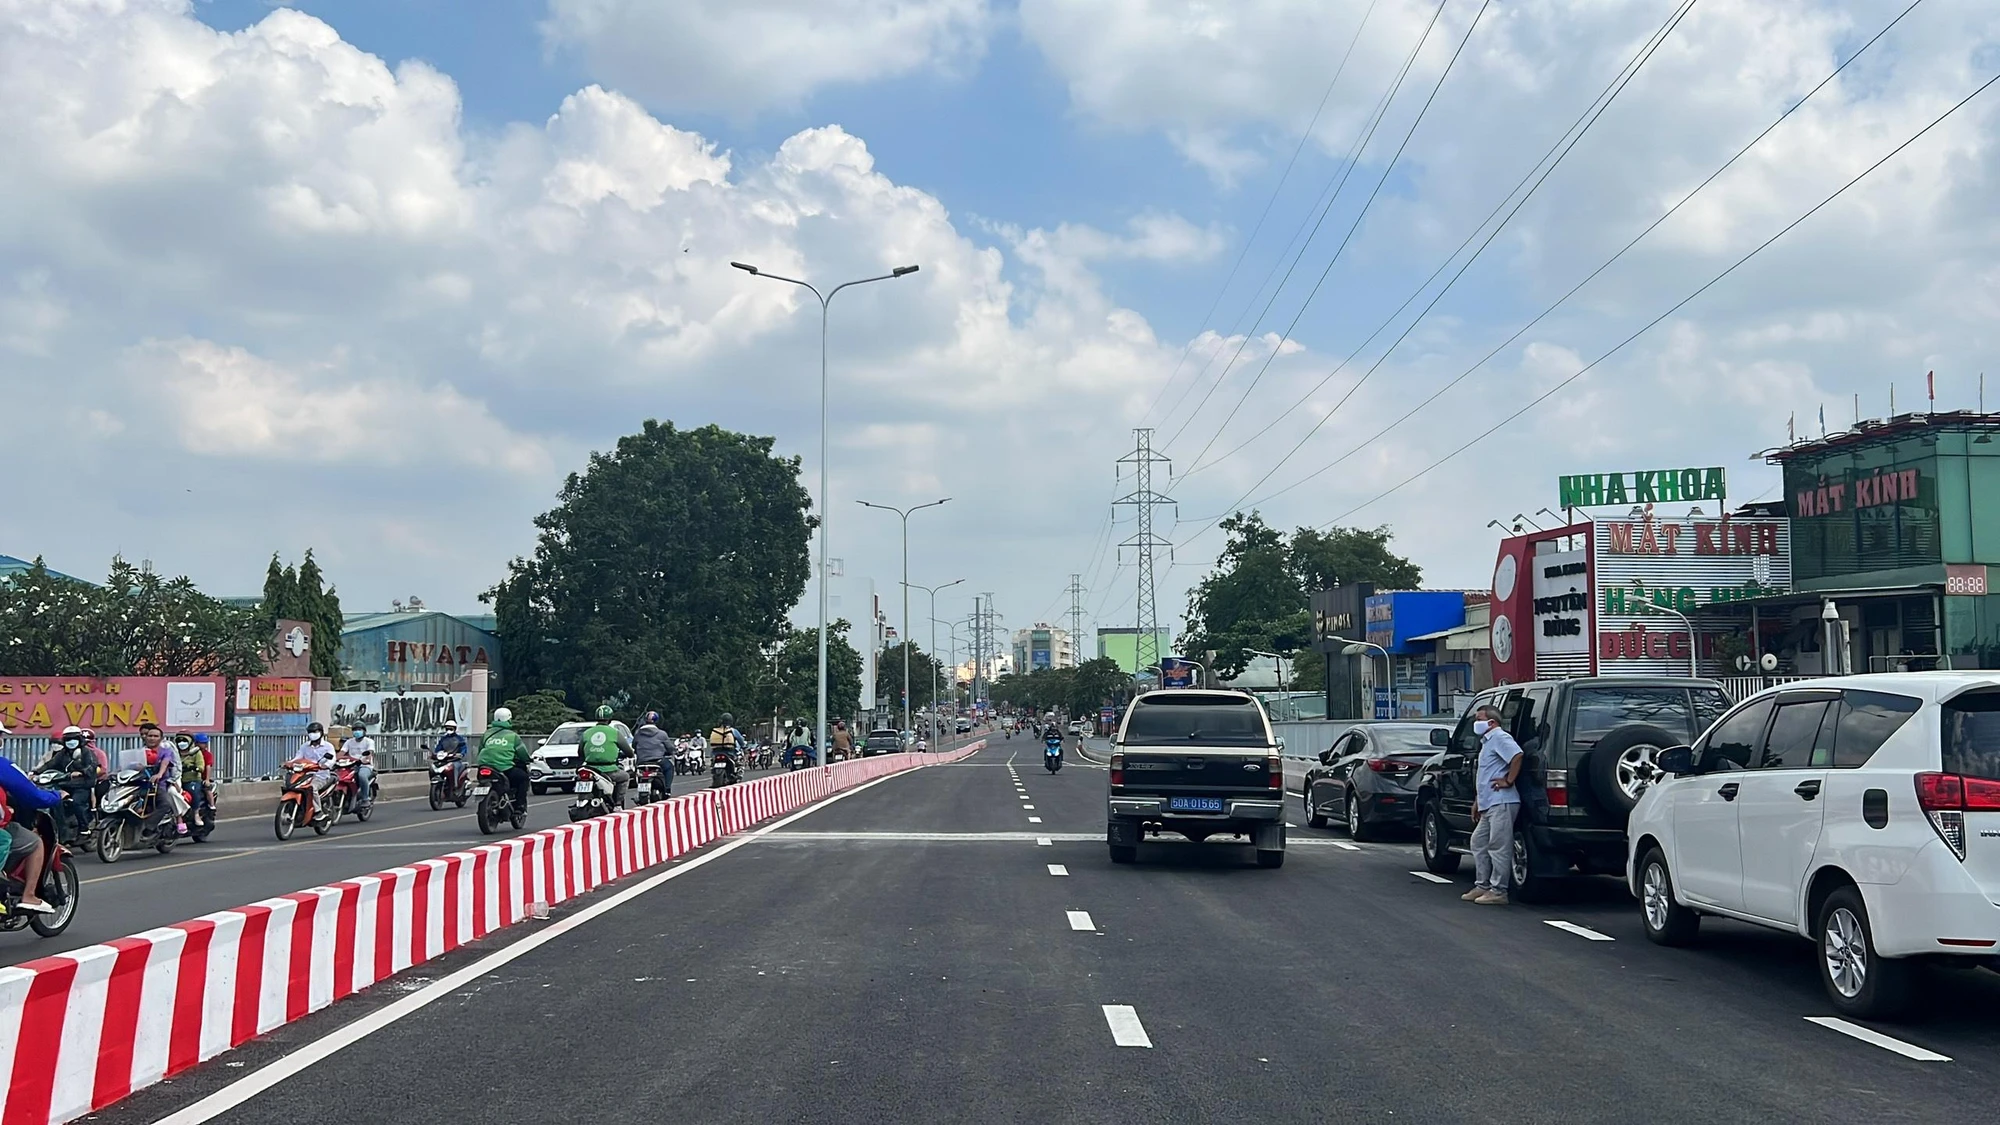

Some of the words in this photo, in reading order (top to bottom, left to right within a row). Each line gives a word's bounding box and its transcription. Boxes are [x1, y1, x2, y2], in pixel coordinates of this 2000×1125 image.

[1559, 472, 1628, 508] NHA
[1635, 466, 1726, 503] KHOA
[1856, 467, 1919, 509] KÍNH
[1694, 512, 1778, 555] KÍNH
[387, 640, 489, 665] HWATA
[21, 683, 51, 694] TY
[63, 701, 159, 727] VINA
[485, 737, 508, 746] Grab
